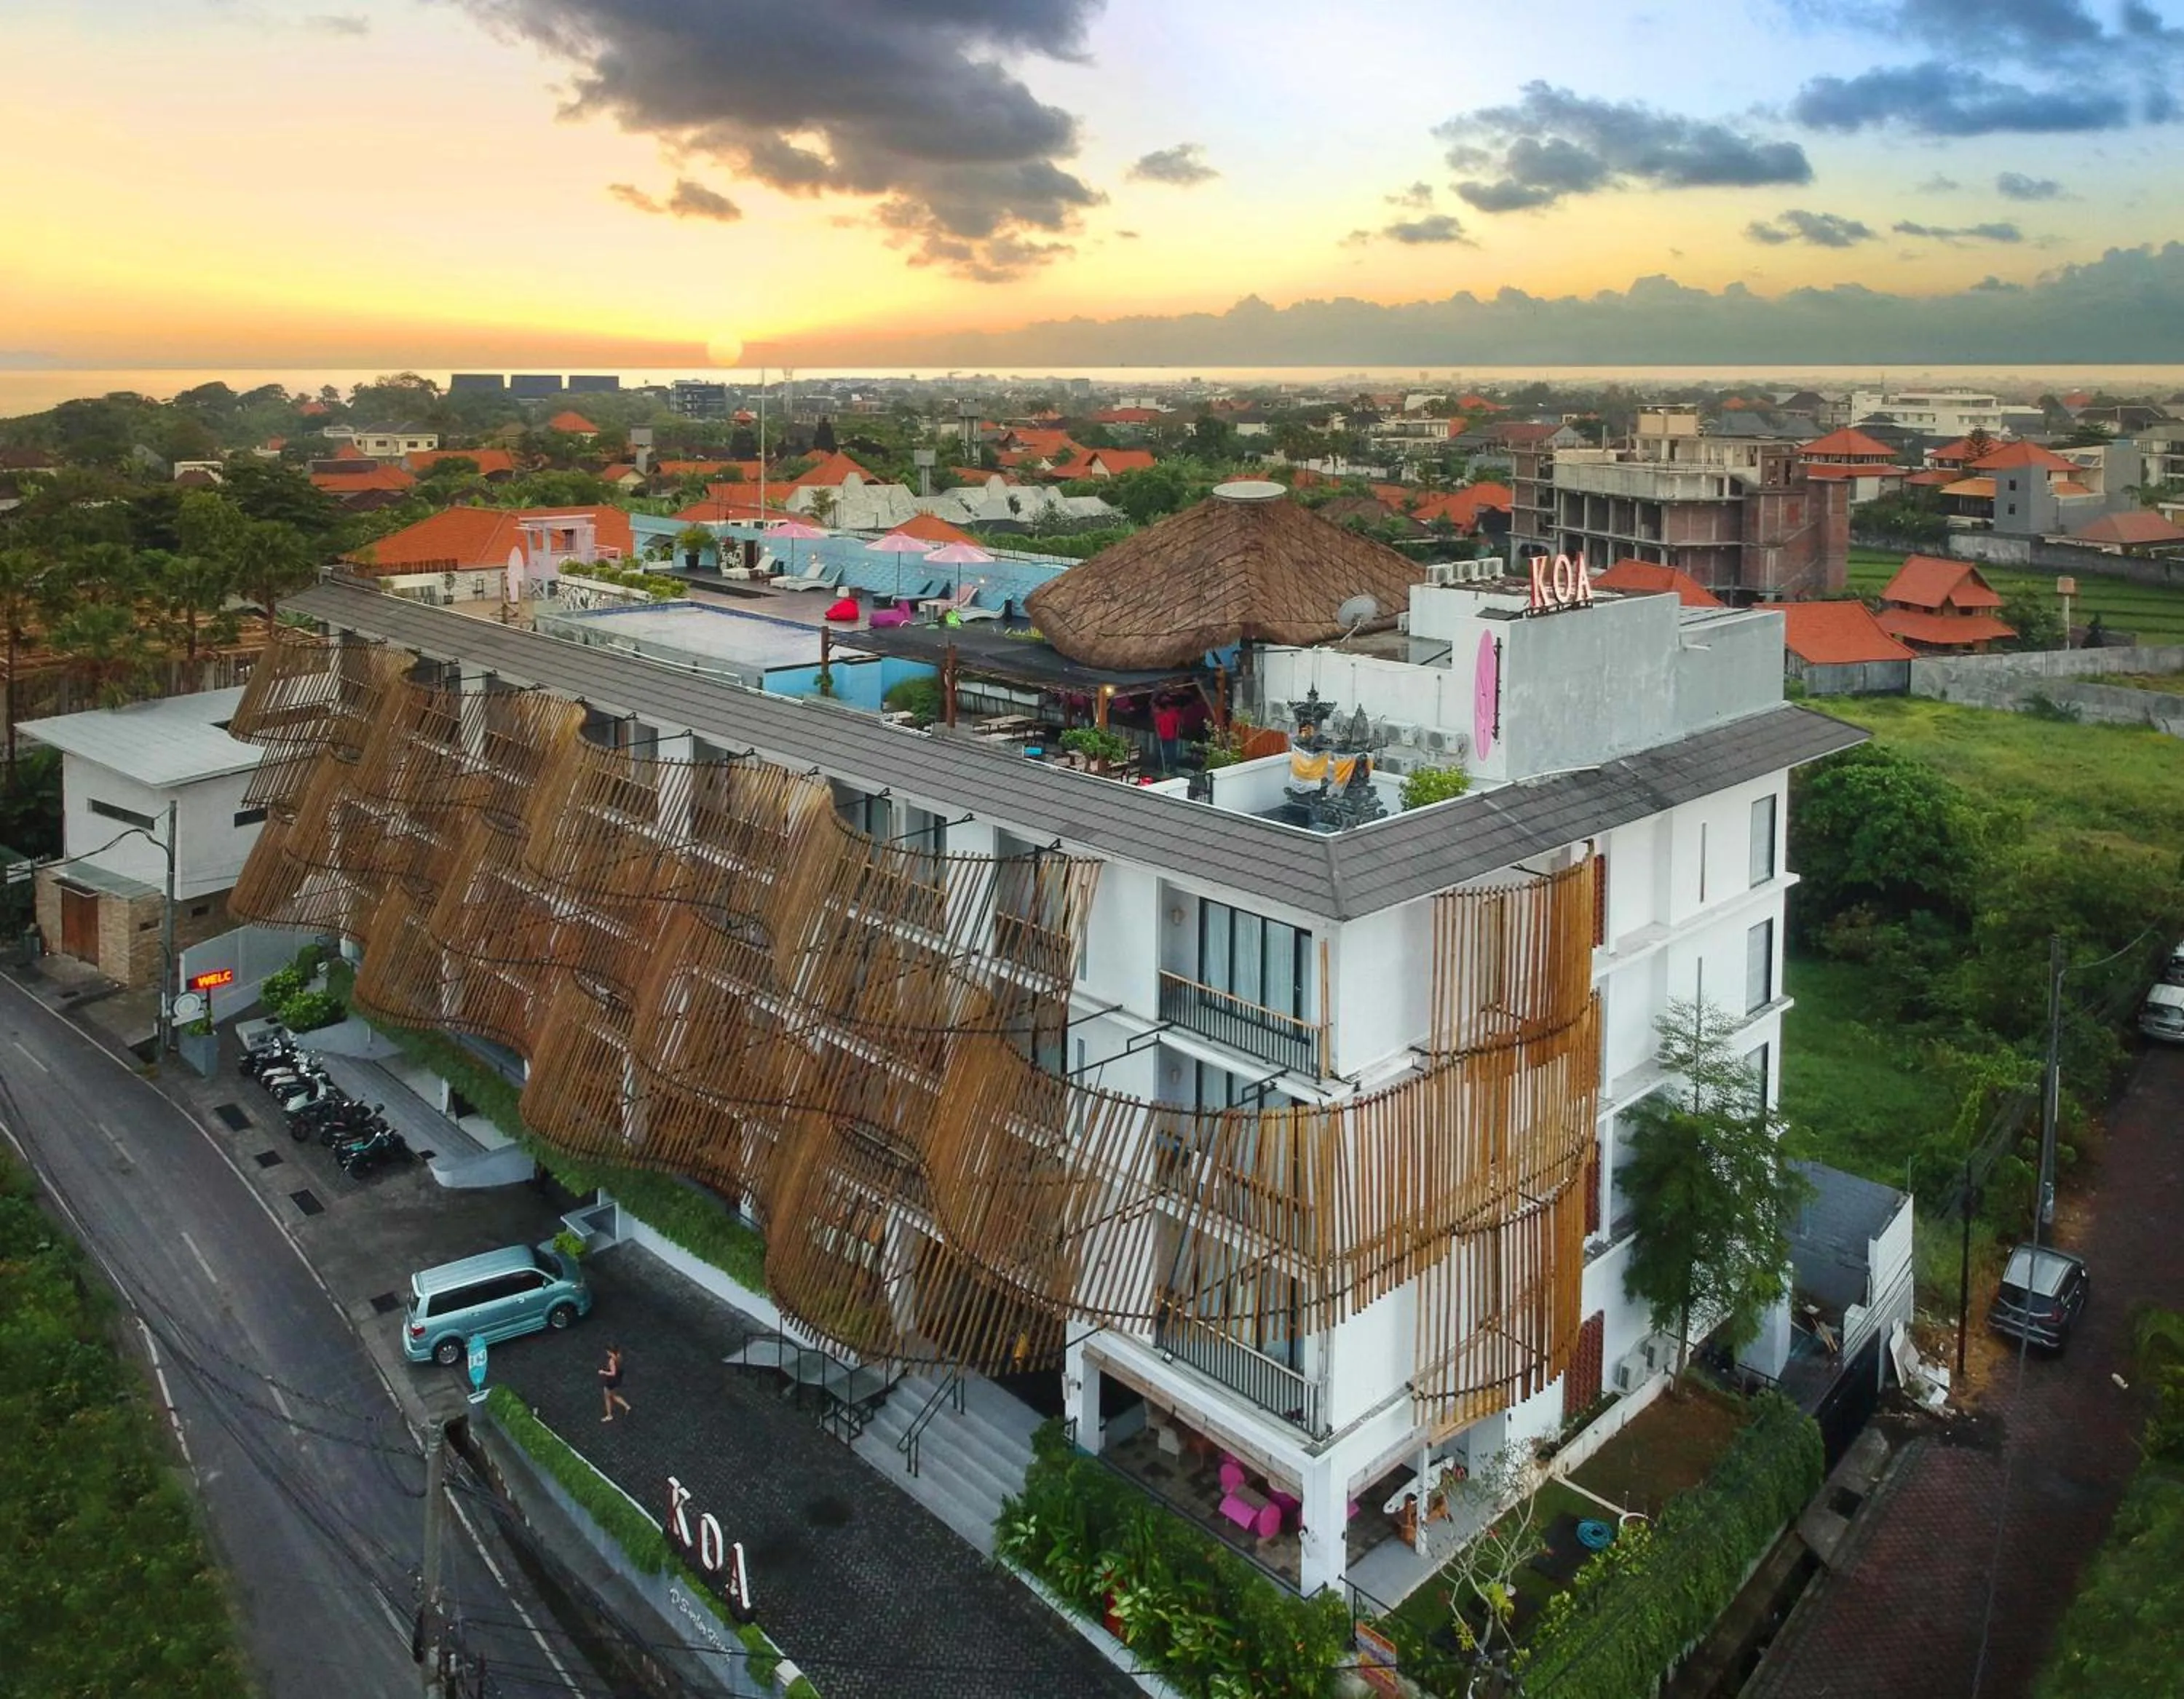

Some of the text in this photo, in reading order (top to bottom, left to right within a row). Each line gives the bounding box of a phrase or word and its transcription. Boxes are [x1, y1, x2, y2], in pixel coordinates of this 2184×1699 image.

[1529, 552, 1594, 607] KOA
[197, 970, 232, 987] WELC
[667, 1476, 751, 1609] KOA
